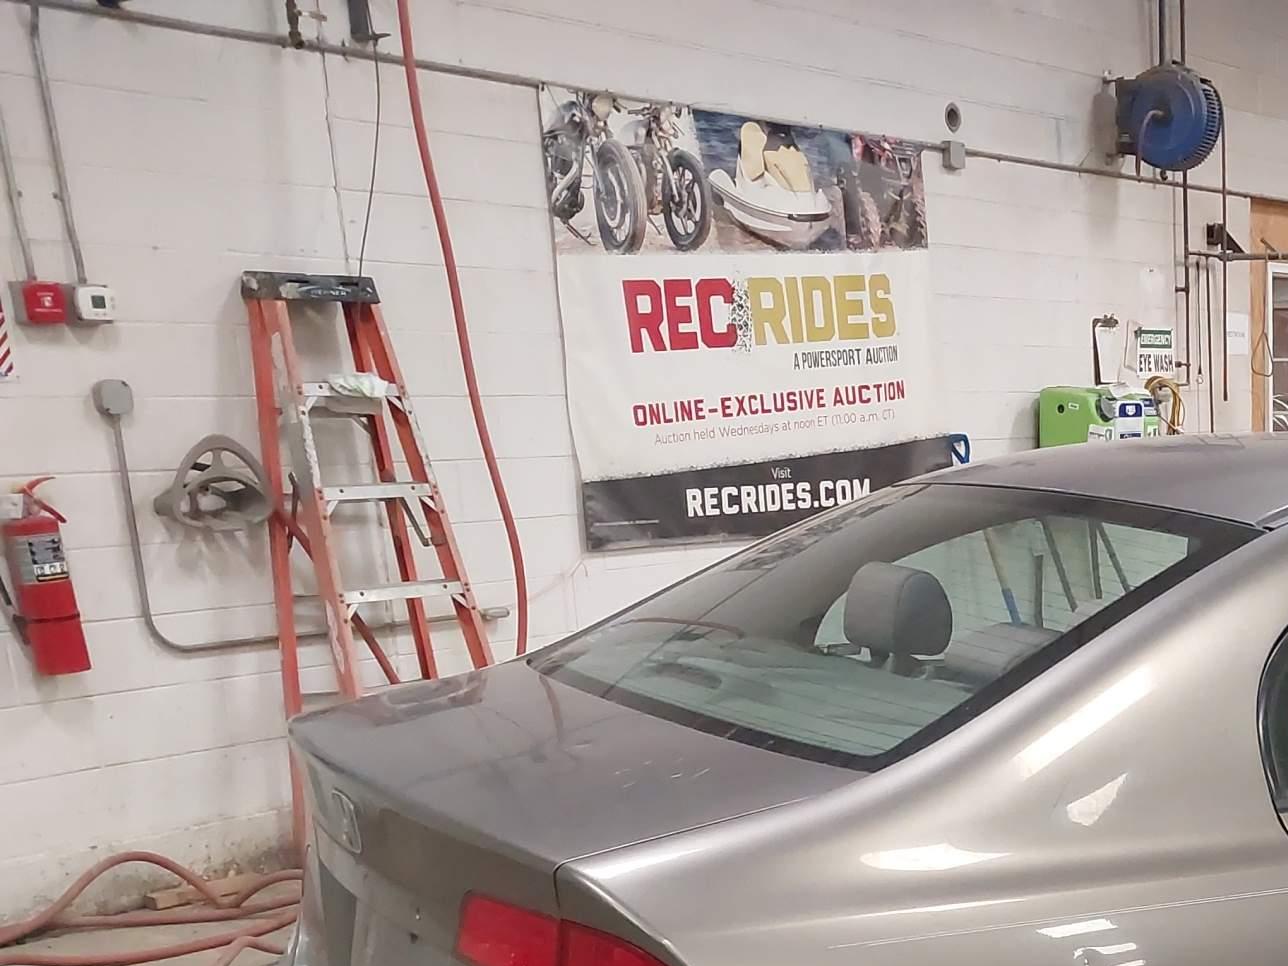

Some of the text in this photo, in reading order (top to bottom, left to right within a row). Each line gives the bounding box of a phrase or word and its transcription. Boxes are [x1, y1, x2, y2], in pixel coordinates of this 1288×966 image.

[793, 344, 898, 370] A POWERSPORT AUCTION
[1138, 353, 1174, 373] EYE WASH
[632, 380, 906, 427] ONLINE-EXCLUSIVE AUCTION
[654, 430, 691, 446] Auction
[692, 427, 715, 441] held
[719, 422, 780, 439] Wednesdays
[781, 420, 792, 431] at
[794, 419, 816, 431] noon
[817, 415, 830, 427] ET
[881, 407, 896, 421] CT)
[770, 466, 792, 481] Visit
[685, 478, 871, 517] RECRIDES.COM
